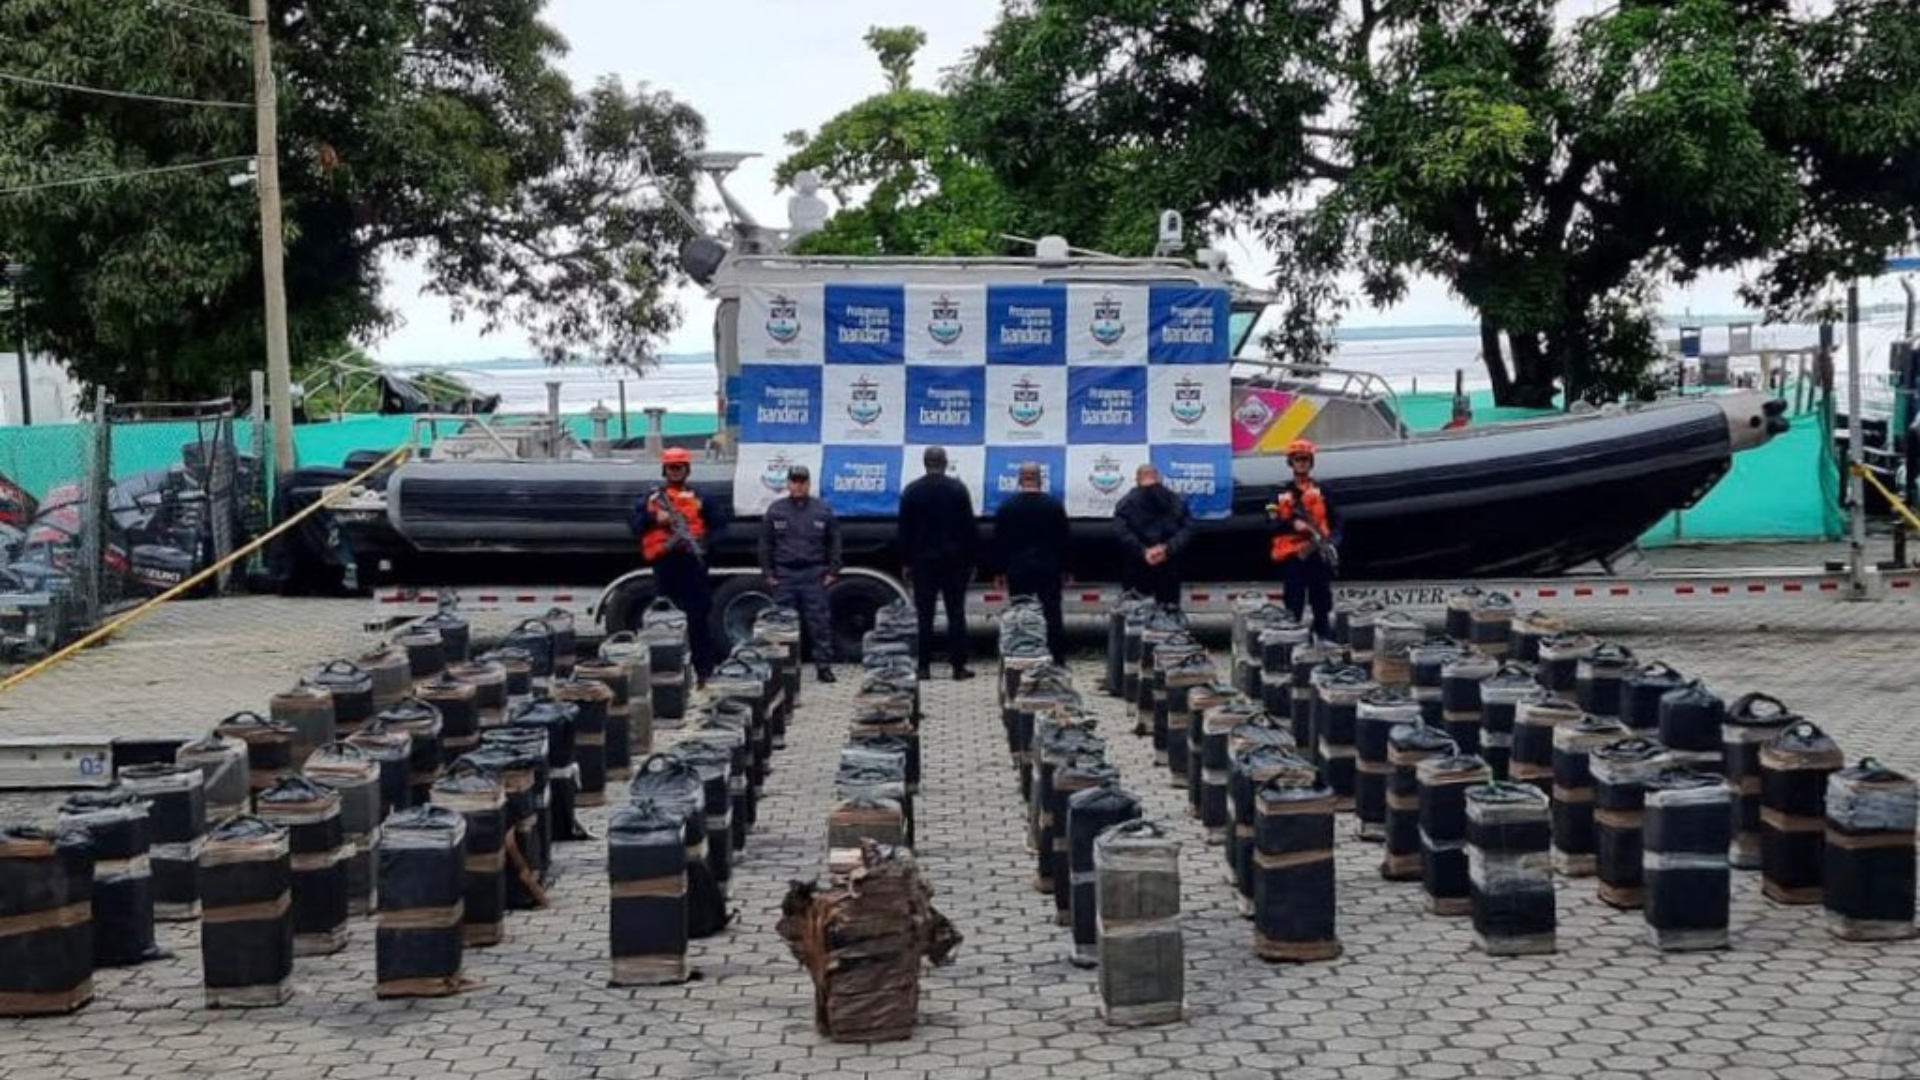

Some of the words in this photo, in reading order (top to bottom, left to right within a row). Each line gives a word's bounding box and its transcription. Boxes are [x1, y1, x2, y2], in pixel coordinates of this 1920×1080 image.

[838, 325, 890, 343] bandera
[1000, 325, 1052, 344] bandera
[1162, 325, 1214, 344] bandera
[757, 404, 809, 423] bandera
[920, 406, 970, 426] bandera
[1081, 405, 1133, 425] bandera
[834, 473, 886, 492] bandera
